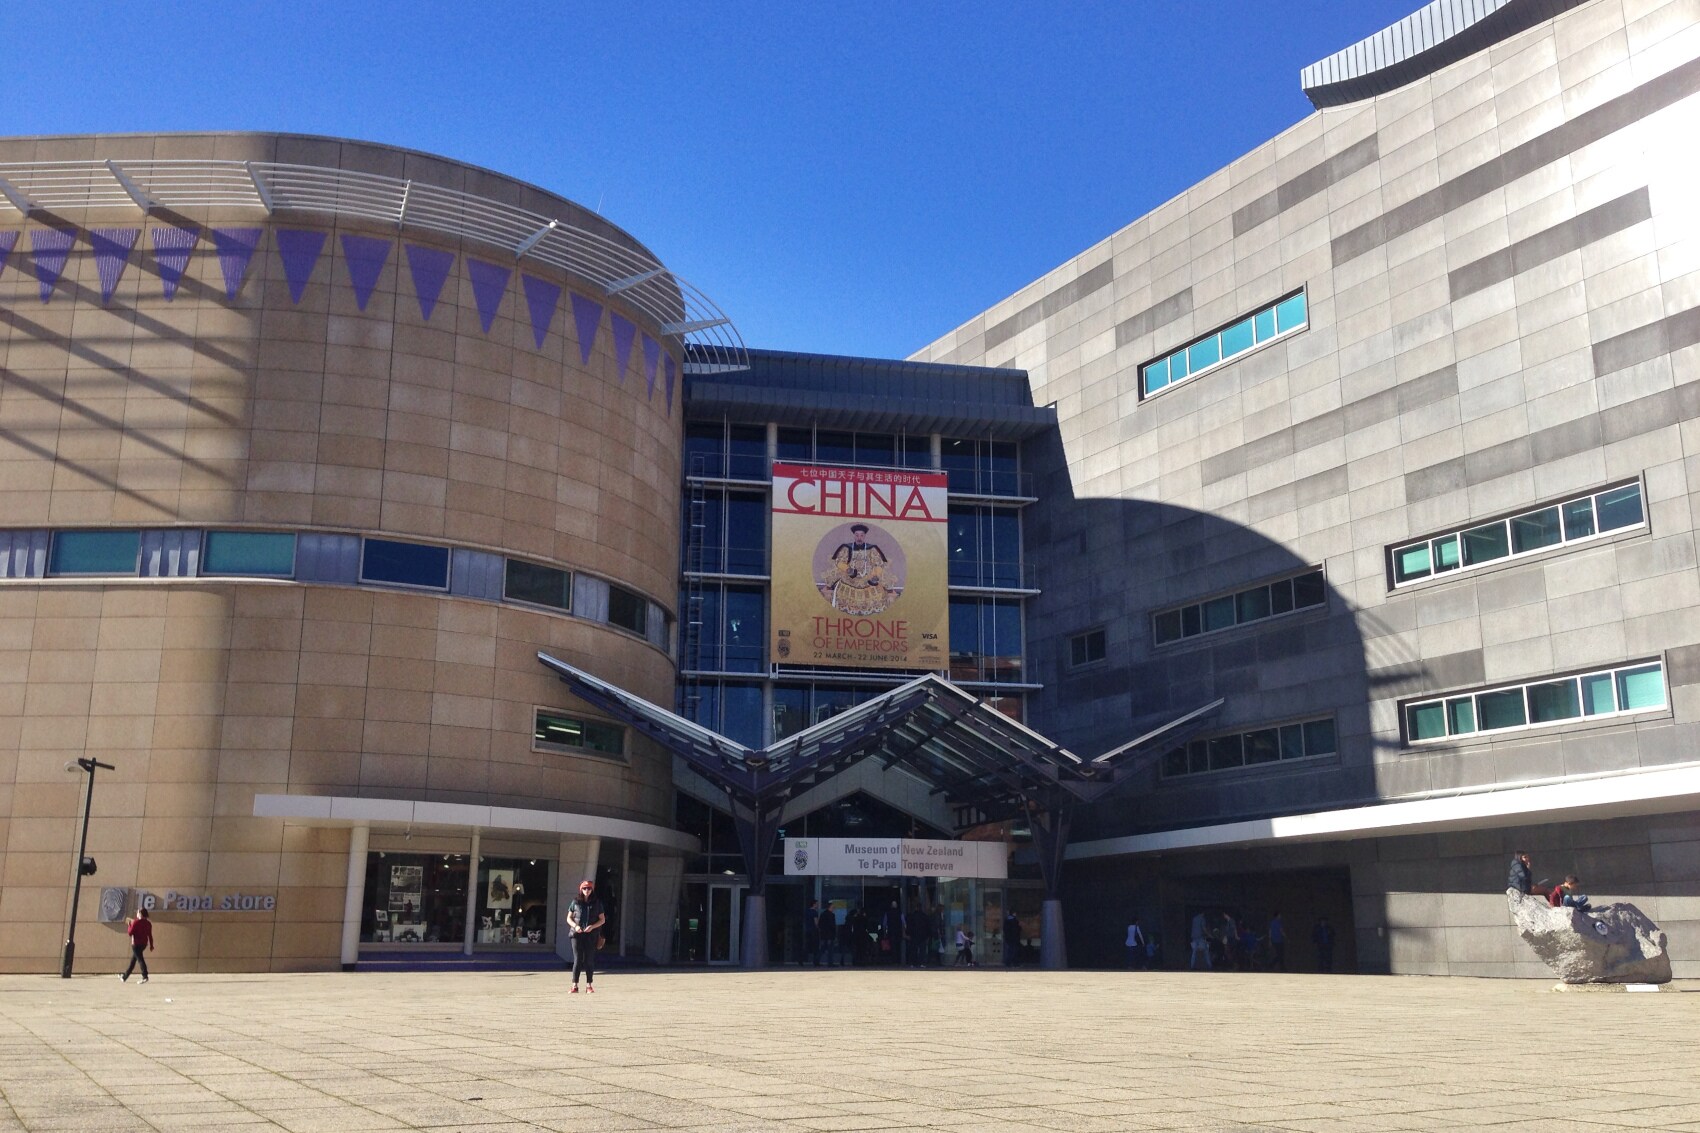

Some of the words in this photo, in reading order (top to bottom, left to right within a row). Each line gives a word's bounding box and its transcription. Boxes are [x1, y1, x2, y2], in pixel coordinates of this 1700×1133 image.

[787, 478, 933, 520] CHINA
[812, 616, 908, 639] THRONE
[813, 637, 832, 649] OF
[836, 638, 908, 653] EMPERORS
[844, 844, 888, 855] Museum
[888, 844, 900, 855] of
[902, 845, 925, 855] New
[927, 845, 964, 857] Zealand
[858, 859, 869, 869] Te
[872, 859, 897, 872] Papa
[902, 859, 954, 872] Tongarewa
[136, 890, 155, 911] Te
[163, 890, 213, 913] Papa
[220, 891, 276, 911] store
